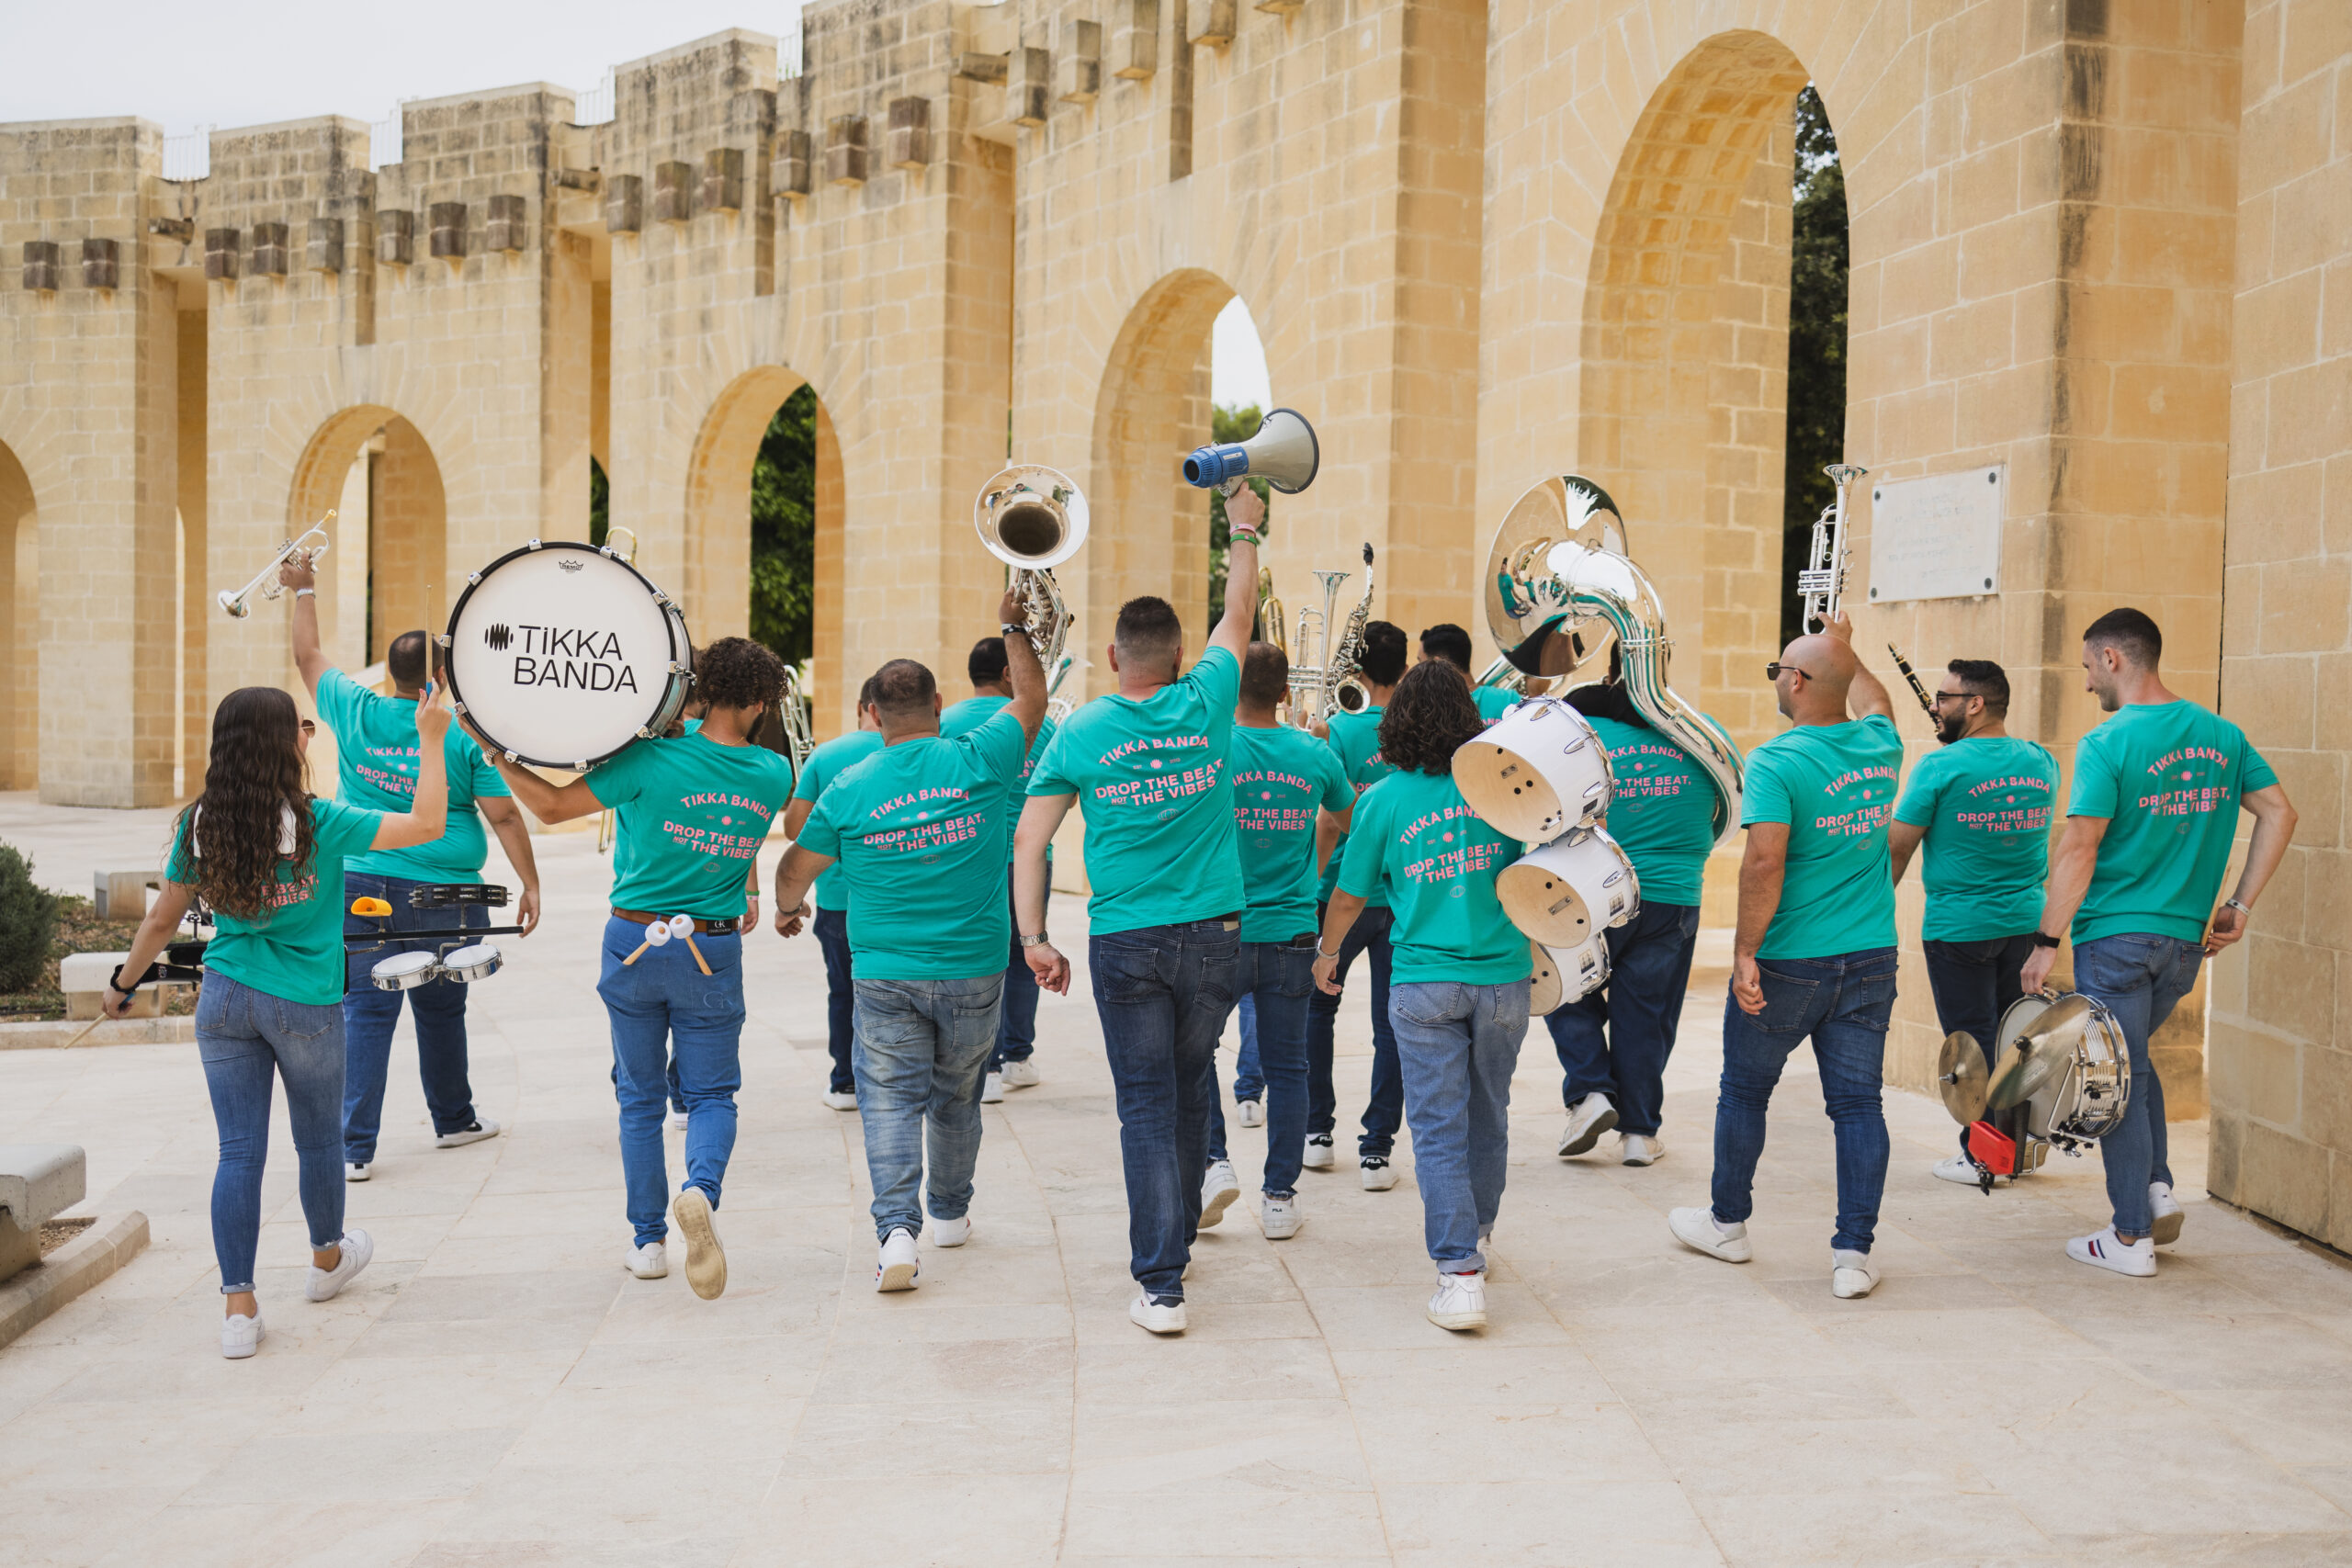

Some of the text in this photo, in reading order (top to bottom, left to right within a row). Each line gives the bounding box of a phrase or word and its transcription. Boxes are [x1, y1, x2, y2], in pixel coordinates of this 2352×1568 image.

[514, 656, 639, 694] BANDA
[366, 747, 403, 757] TIKKA
[1099, 735, 1209, 766] TIKKA BANDA
[1608, 744, 1683, 762] KKA BANDA
[356, 763, 413, 785] DROP THE
[2147, 750, 2183, 776] TIKKA
[378, 781, 401, 792] THE
[1095, 759, 1224, 799] DROP THE BEAT,
[1232, 771, 1312, 795] IKKA BANDA
[1624, 777, 1651, 787] THE
[1655, 775, 1691, 785] BEAT,
[1825, 771, 1863, 796] TIKKA
[1968, 776, 2050, 798] TIKKA BANDA
[1111, 776, 1216, 807] NOT THE VIBES
[1615, 785, 1679, 798] HE VIBES
[2174, 789, 2199, 803] THE
[681, 793, 772, 822] TIKKA BANDA
[869, 787, 970, 820] TIKKA BANDA
[1252, 808, 1279, 818] THE
[1283, 809, 1314, 819] BEAT,
[1238, 819, 1306, 830] THE VIBES
[1400, 805, 1483, 845] TIKKA BAN
[1815, 813, 1854, 829] DROP
[1857, 806, 1882, 821] THE
[1957, 812, 1996, 822] DROP
[1999, 810, 2024, 821] THE
[1985, 821, 2011, 832] THE
[2015, 818, 2046, 830] VIBES
[663, 820, 705, 840] DROP
[709, 831, 737, 845] THE
[864, 812, 986, 845] DROP THE BEAT,
[896, 838, 928, 852] THE
[932, 827, 978, 846] VIBES
[1843, 821, 1871, 837] THE
[691, 840, 719, 856] THE
[722, 847, 757, 859] VIBES
[1438, 849, 1465, 866] THE
[1467, 842, 1503, 859] BEAT,
[1425, 866, 1456, 883] THE
[1458, 857, 1491, 875] VIBES
